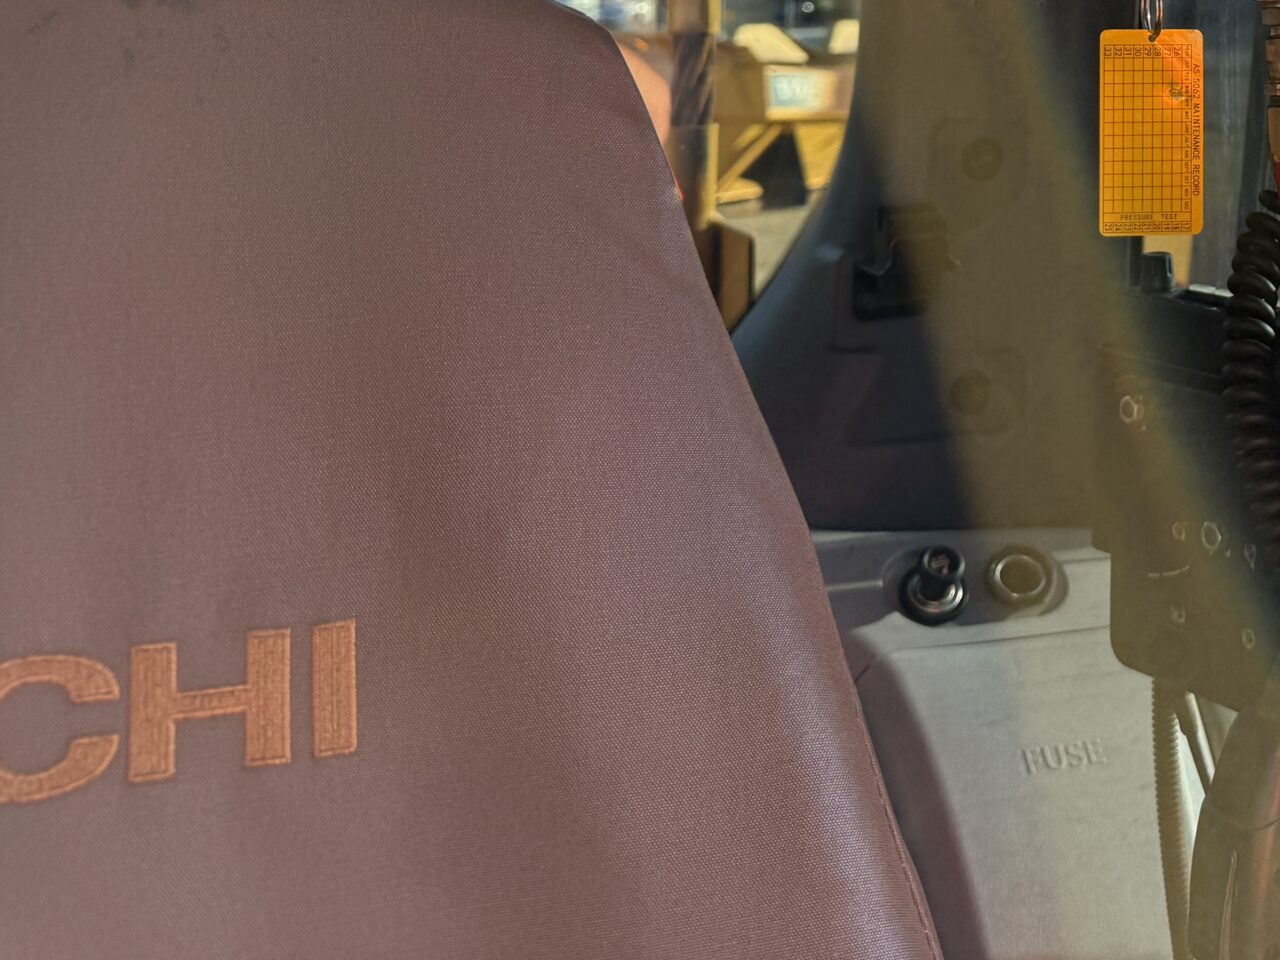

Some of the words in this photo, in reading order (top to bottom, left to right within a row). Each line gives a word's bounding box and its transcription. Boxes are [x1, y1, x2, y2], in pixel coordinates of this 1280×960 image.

[1104, 46, 1112, 57] 33
[1114, 46, 1122, 57] 32
[1124, 46, 1132, 57] 31
[1134, 46, 1142, 57] 30
[1144, 46, 1152, 57] 29
[1154, 46, 1162, 57] 28
[1164, 46, 1171, 57] 27
[1174, 46, 1181, 57] 26
[1192, 63, 1201, 74] AS
[1192, 78, 1201, 99] 5062
[1192, 103, 1201, 160] MAINTENANCE
[1192, 164, 1201, 196] RECORD
[1105, 223, 1113, 231] 25
[1022, 738, 1107, 775] FUSE
